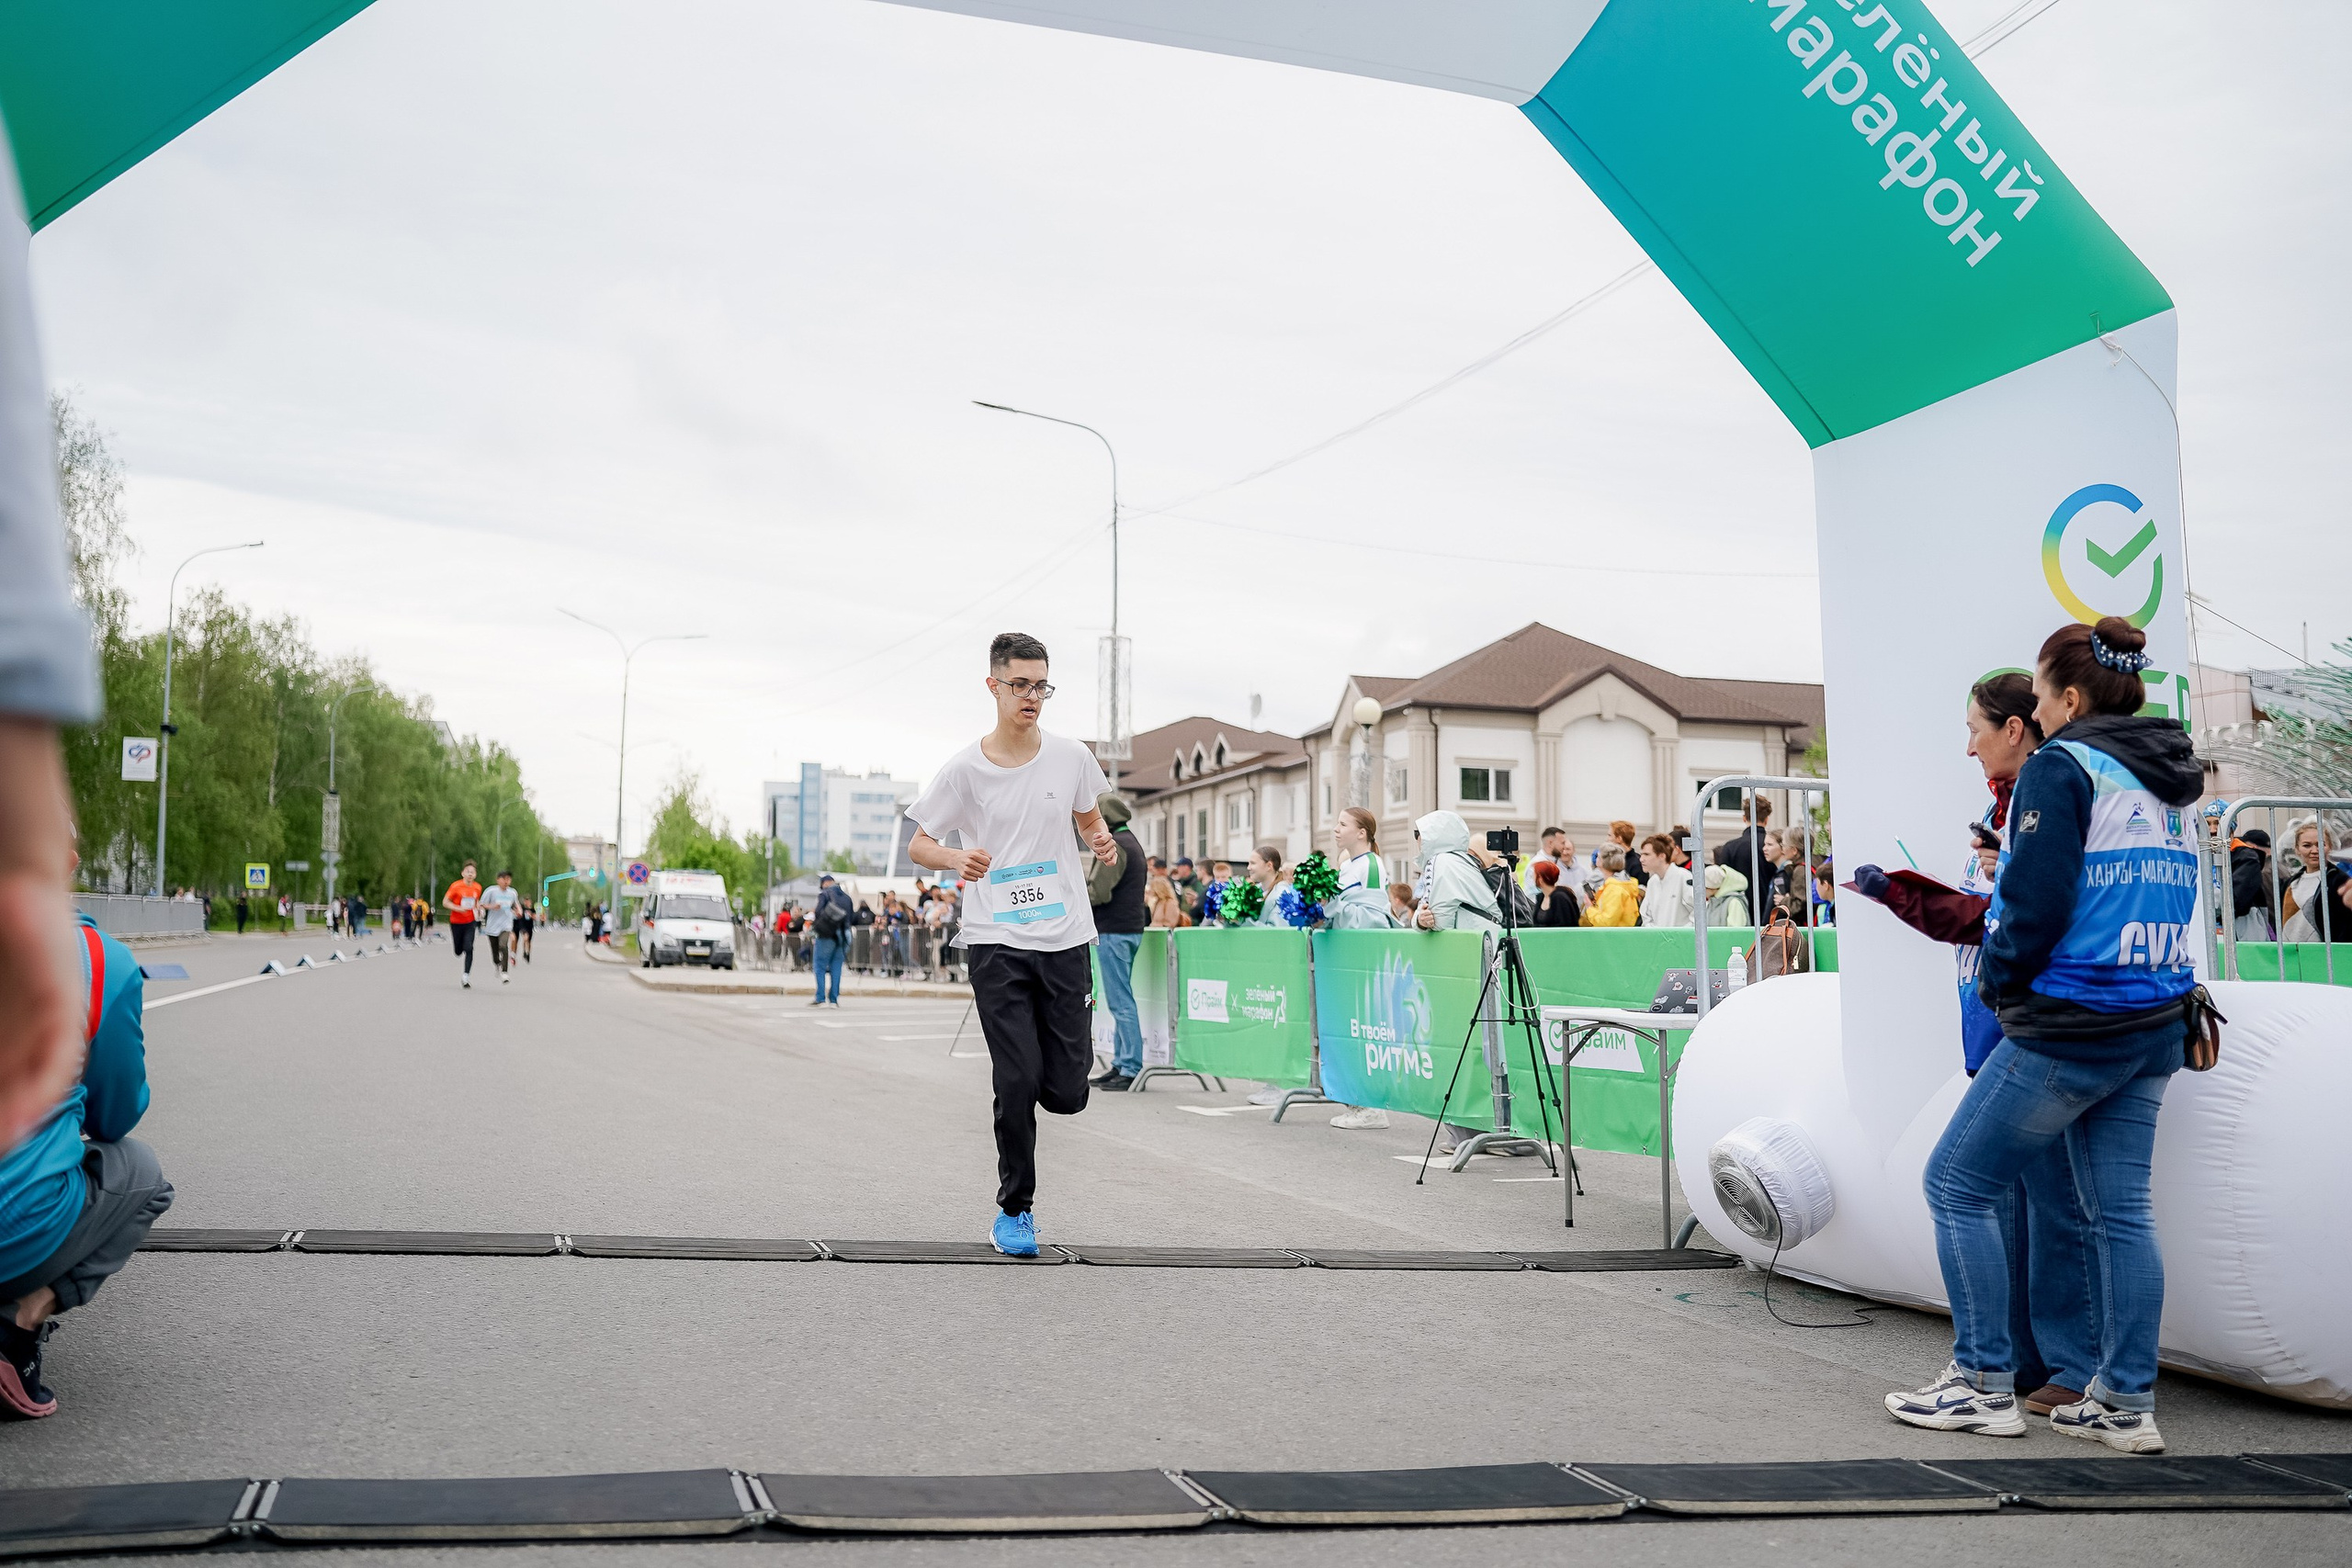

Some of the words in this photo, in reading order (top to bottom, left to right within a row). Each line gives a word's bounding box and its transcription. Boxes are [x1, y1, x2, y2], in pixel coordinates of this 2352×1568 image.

[1837, 0, 2045, 222] лёный
[1010, 886, 1045, 906] 3356
[1245, 984, 1275, 1003] зелёный
[1241, 1002, 1273, 1023] марафон
[1350, 1018, 1359, 1038] В
[1361, 1021, 1396, 1043] твоём
[1364, 1043, 1433, 1080] ритме
